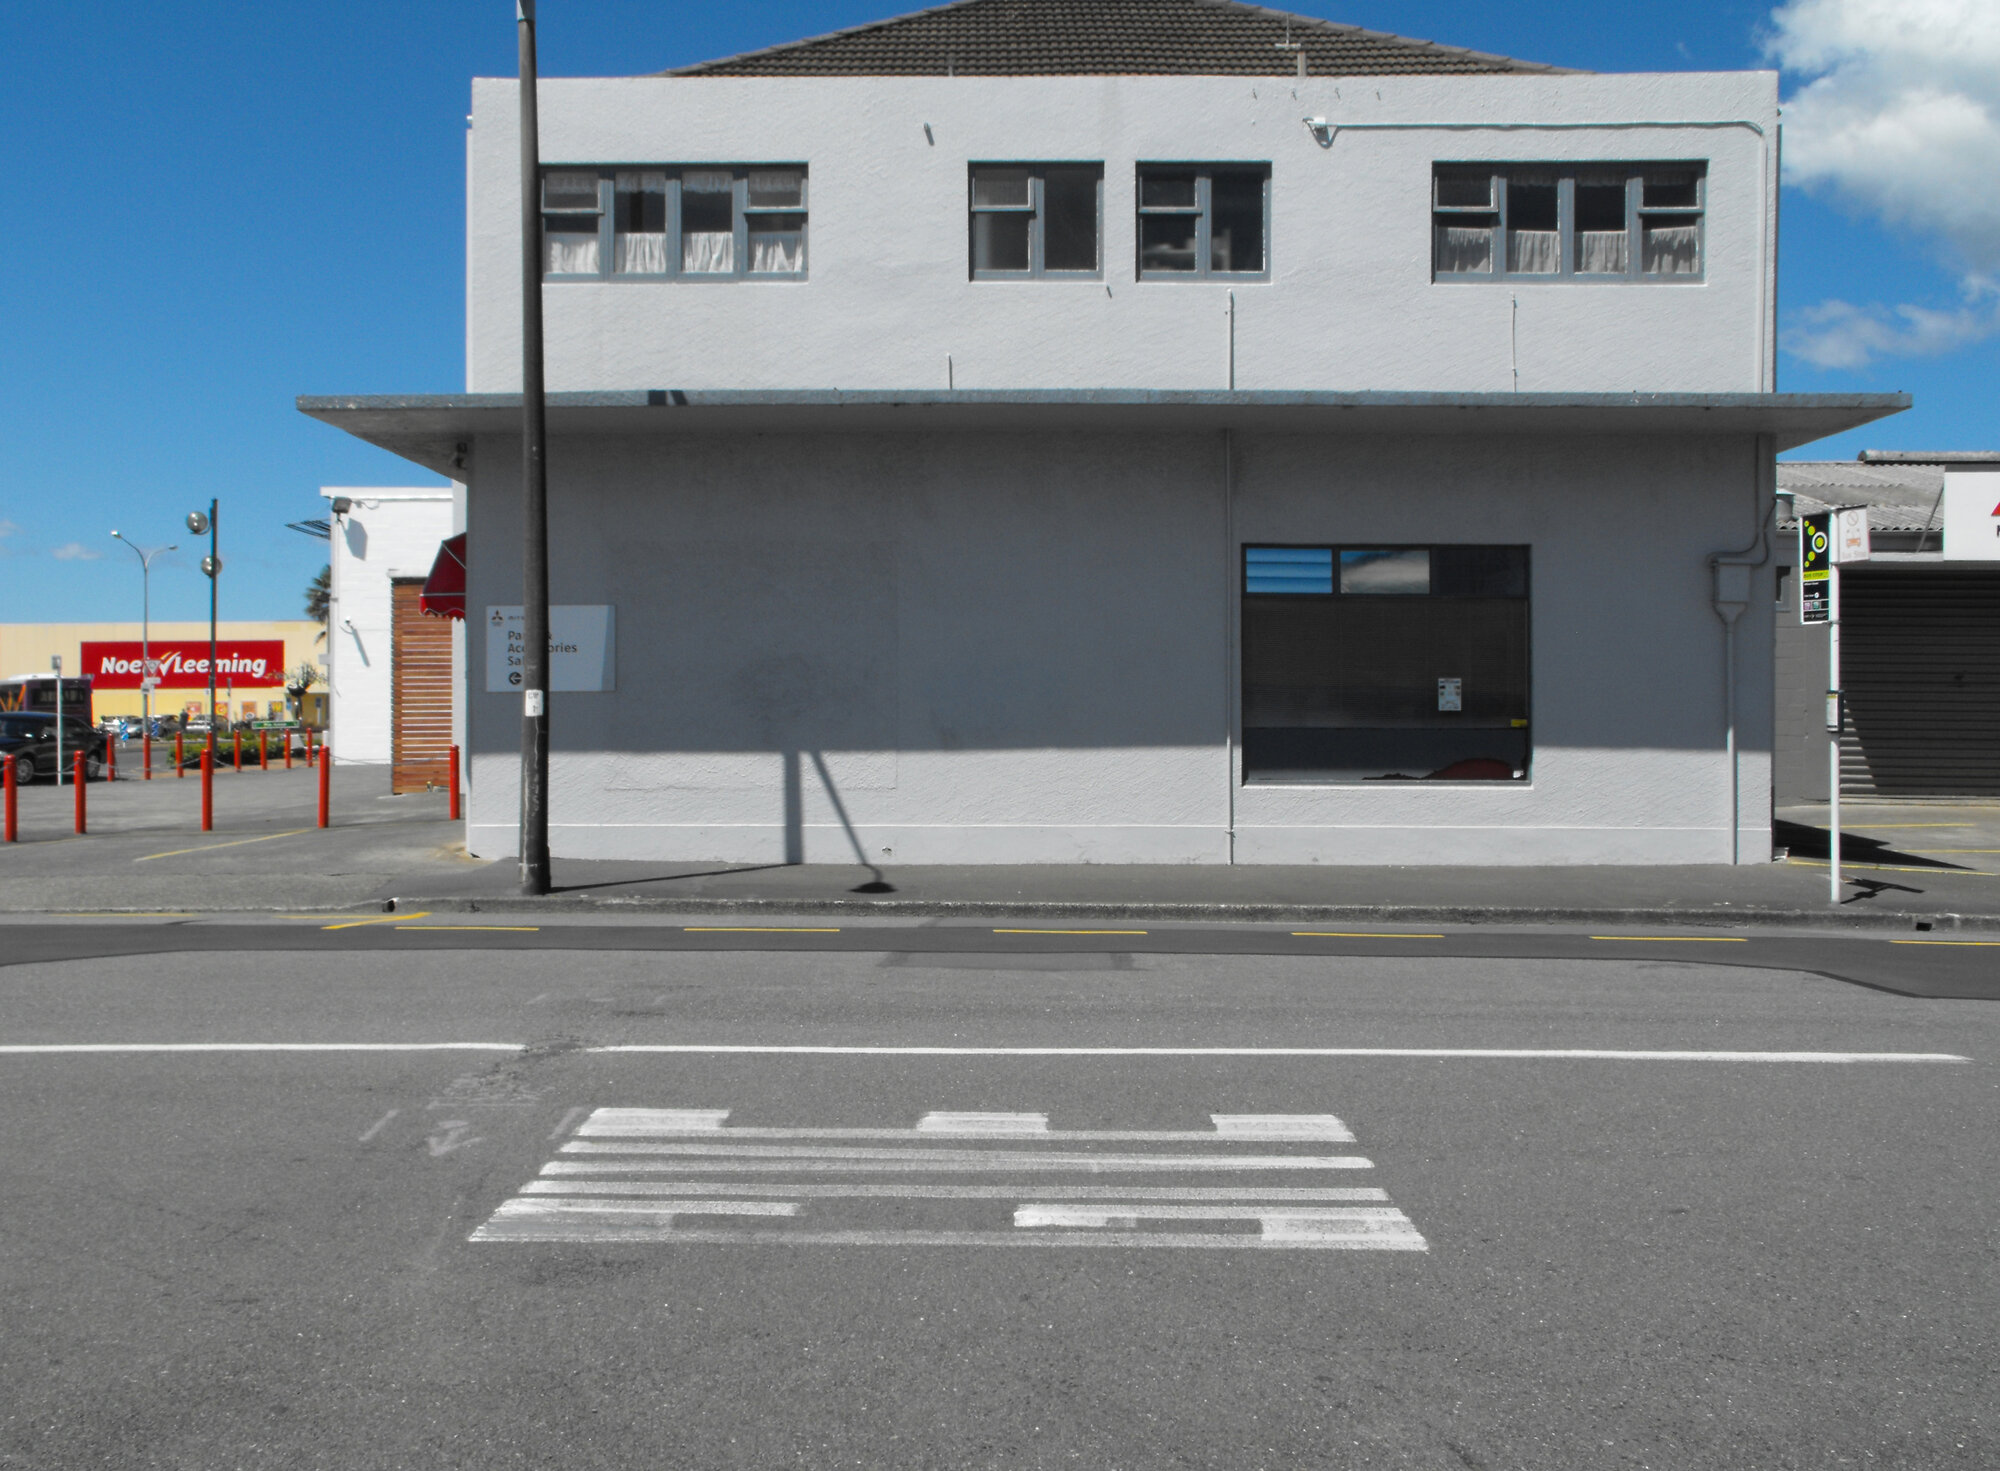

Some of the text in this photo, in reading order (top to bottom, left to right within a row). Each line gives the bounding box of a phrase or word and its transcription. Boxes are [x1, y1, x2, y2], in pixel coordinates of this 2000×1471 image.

[507, 642, 577, 653] Accories
[101, 652, 266, 678] Noe Leeming
